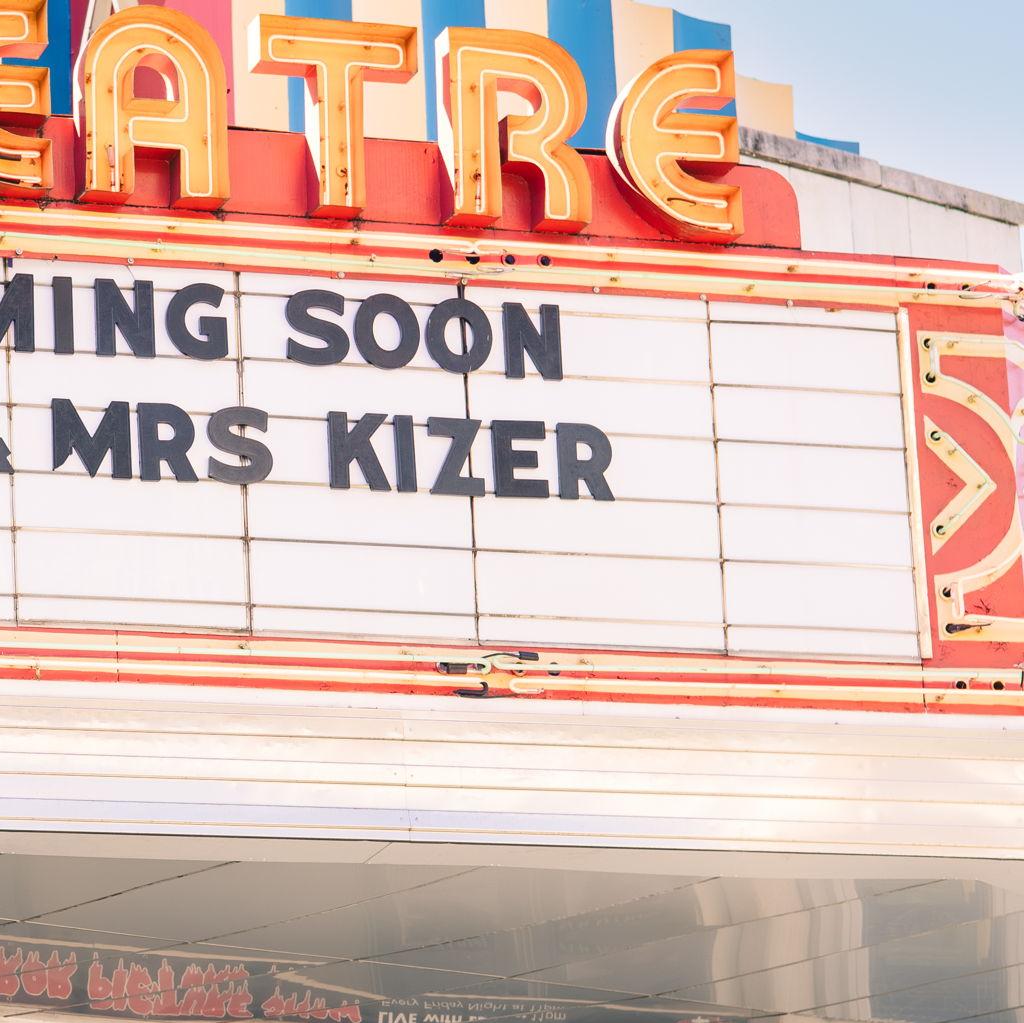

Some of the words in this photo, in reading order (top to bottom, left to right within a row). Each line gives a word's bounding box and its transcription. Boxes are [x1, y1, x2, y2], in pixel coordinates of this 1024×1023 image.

[285, 289, 562, 380] SOON
[52, 397, 273, 485] MRS
[328, 410, 615, 501] KIZER
